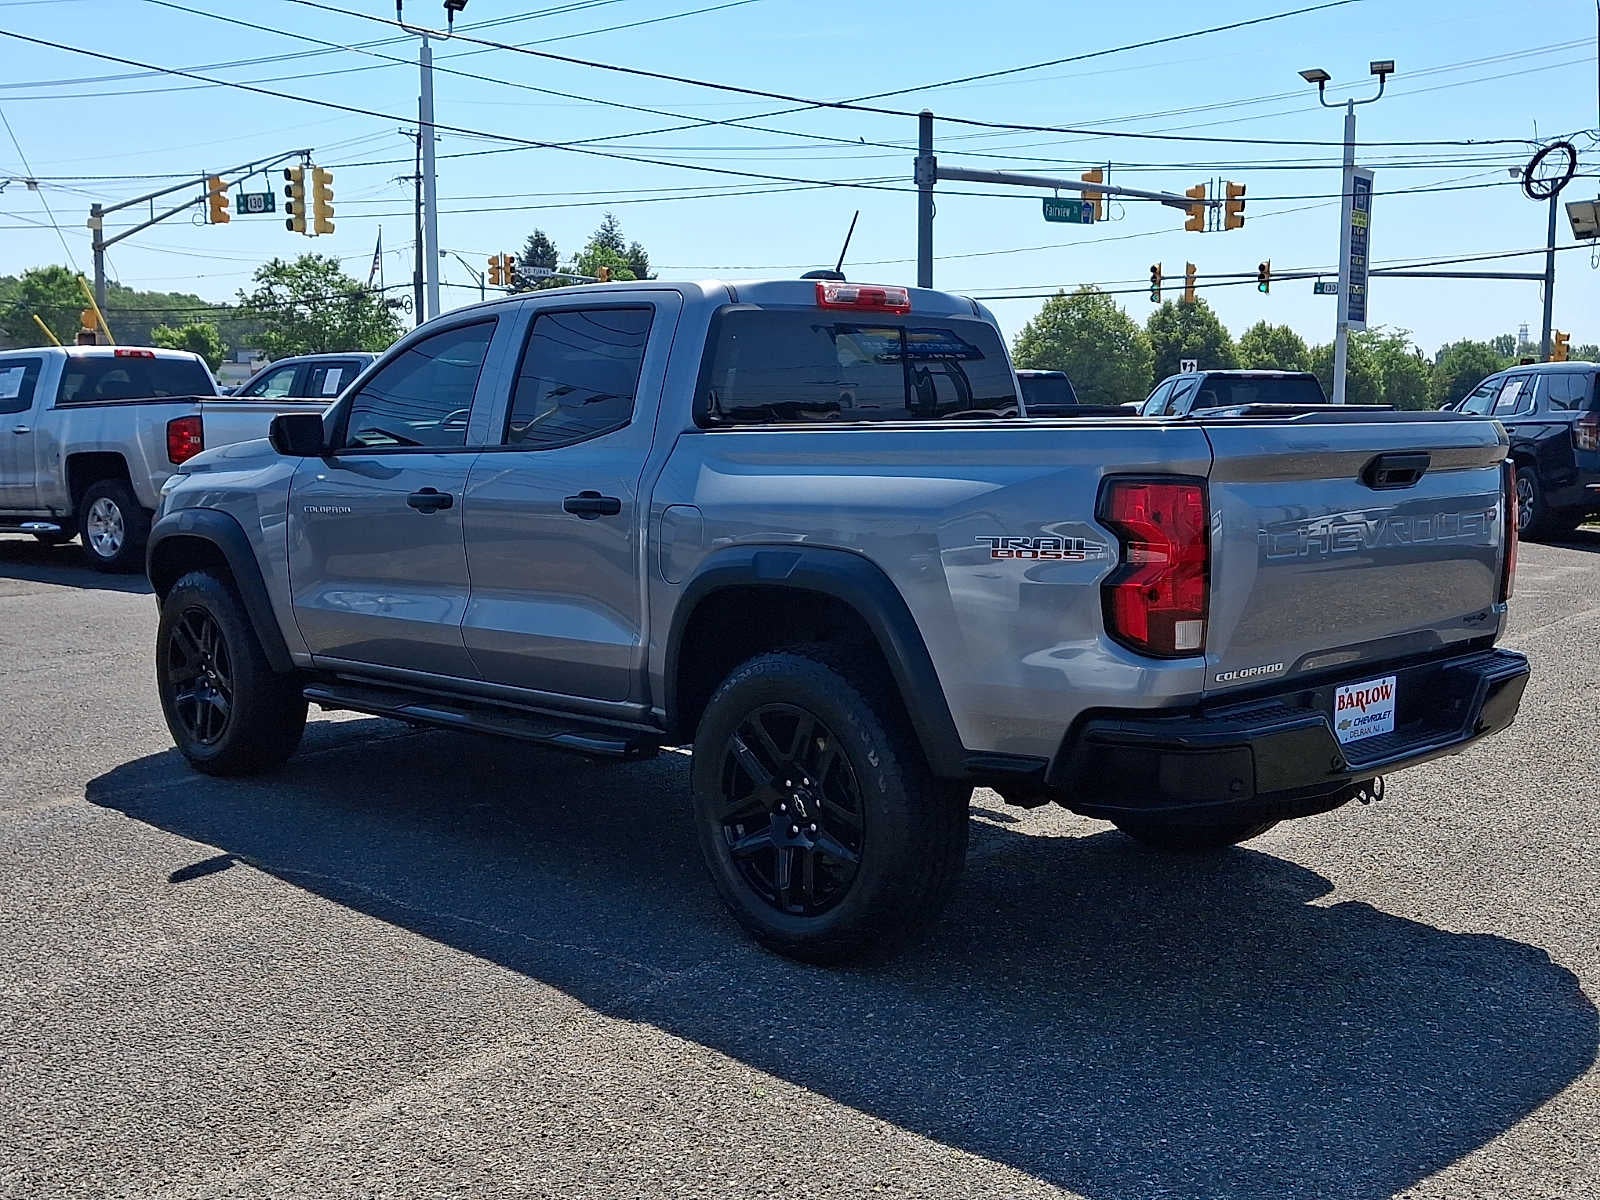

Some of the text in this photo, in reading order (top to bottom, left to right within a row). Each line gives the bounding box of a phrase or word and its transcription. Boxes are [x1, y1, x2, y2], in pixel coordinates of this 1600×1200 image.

[249, 196, 262, 209] 130
[1045, 203, 1071, 217] Fairview
[303, 505, 352, 513] COLORADO
[975, 535, 1103, 551] TRAIL
[1256, 511, 1491, 560] CHEVROLET
[990, 549, 1086, 561] BOSS
[1215, 662, 1284, 682] COLORADO
[1337, 684, 1394, 713] BARLOW
[1353, 710, 1393, 727] CHEVROLET
